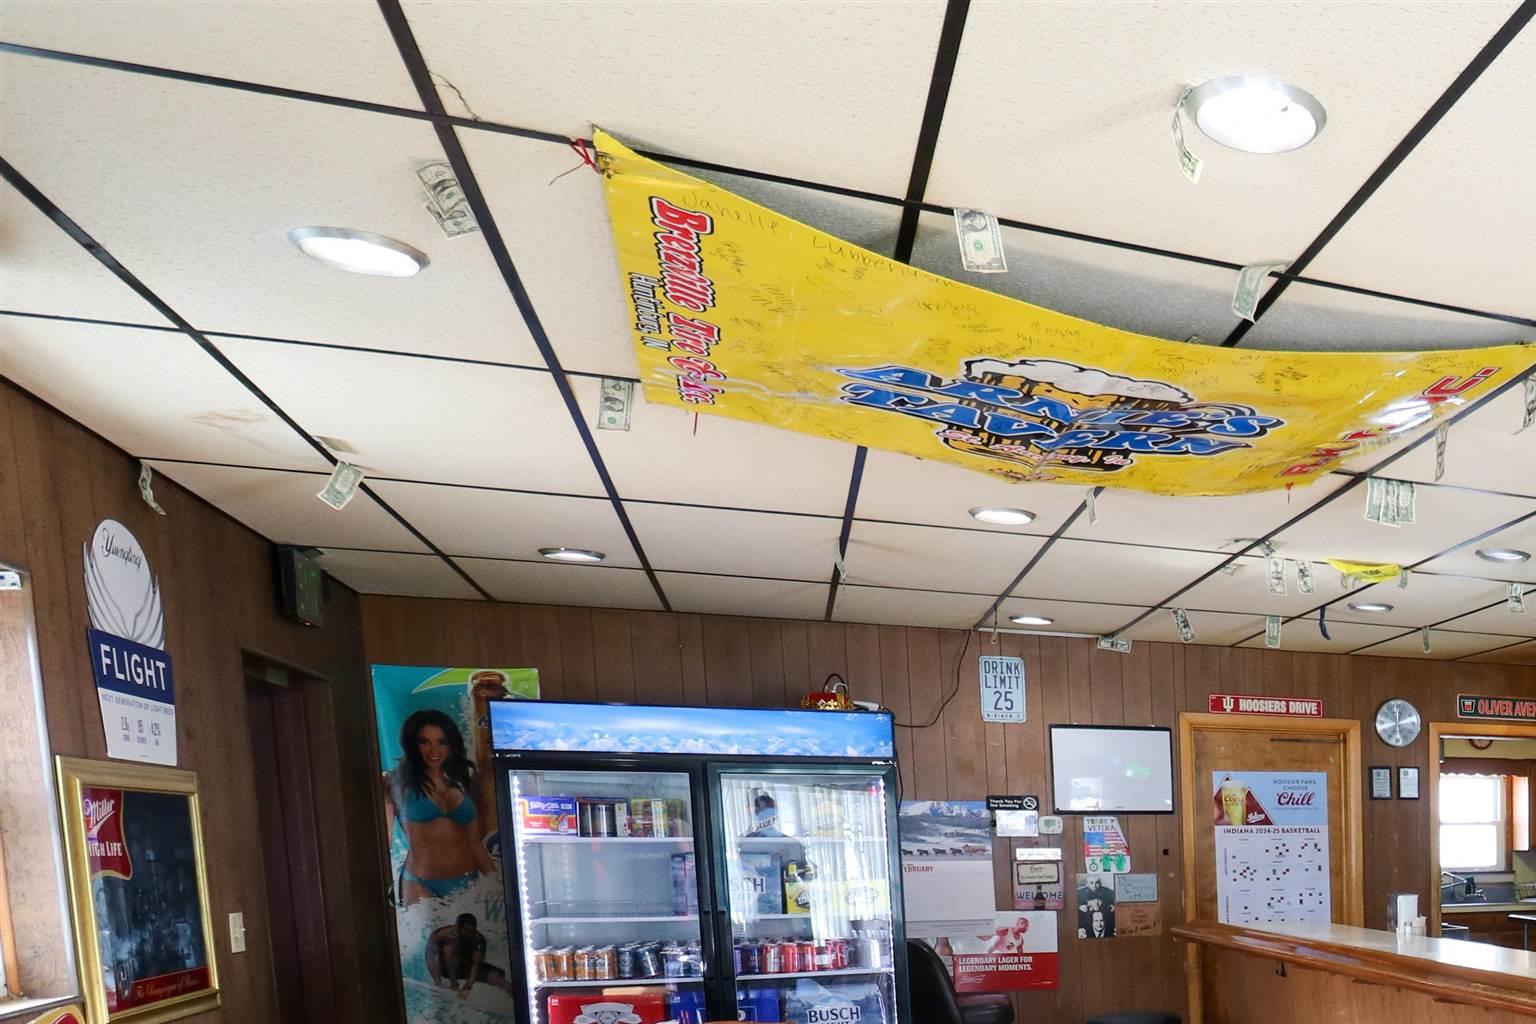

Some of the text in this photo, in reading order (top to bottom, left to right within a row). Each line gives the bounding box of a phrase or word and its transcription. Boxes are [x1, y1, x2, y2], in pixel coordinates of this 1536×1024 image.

[666, 312, 721, 356] Tire
[837, 364, 1287, 438] ARNIE'S
[839, 383, 1254, 455] TAVERN
[101, 527, 142, 570] Yuengling
[100, 643, 166, 691] FLIGHT
[984, 660, 1020, 676] DRINK
[985, 675, 1020, 690] LIMIT
[993, 690, 1014, 711] 25
[1240, 699, 1318, 714] HOOSIERS DRIVE
[1478, 699, 1514, 716] OLIVER
[1277, 791, 1315, 806] Chill
[106, 840, 123, 857] LIFE
[1016, 891, 1064, 900] WELOME
[959, 956, 996, 965] LEGENDARY
[998, 956, 1019, 964] LAGER
[959, 964, 1033, 973] LEGENDARY MOMENTS.
[808, 1007, 860, 1024] BUSCH
